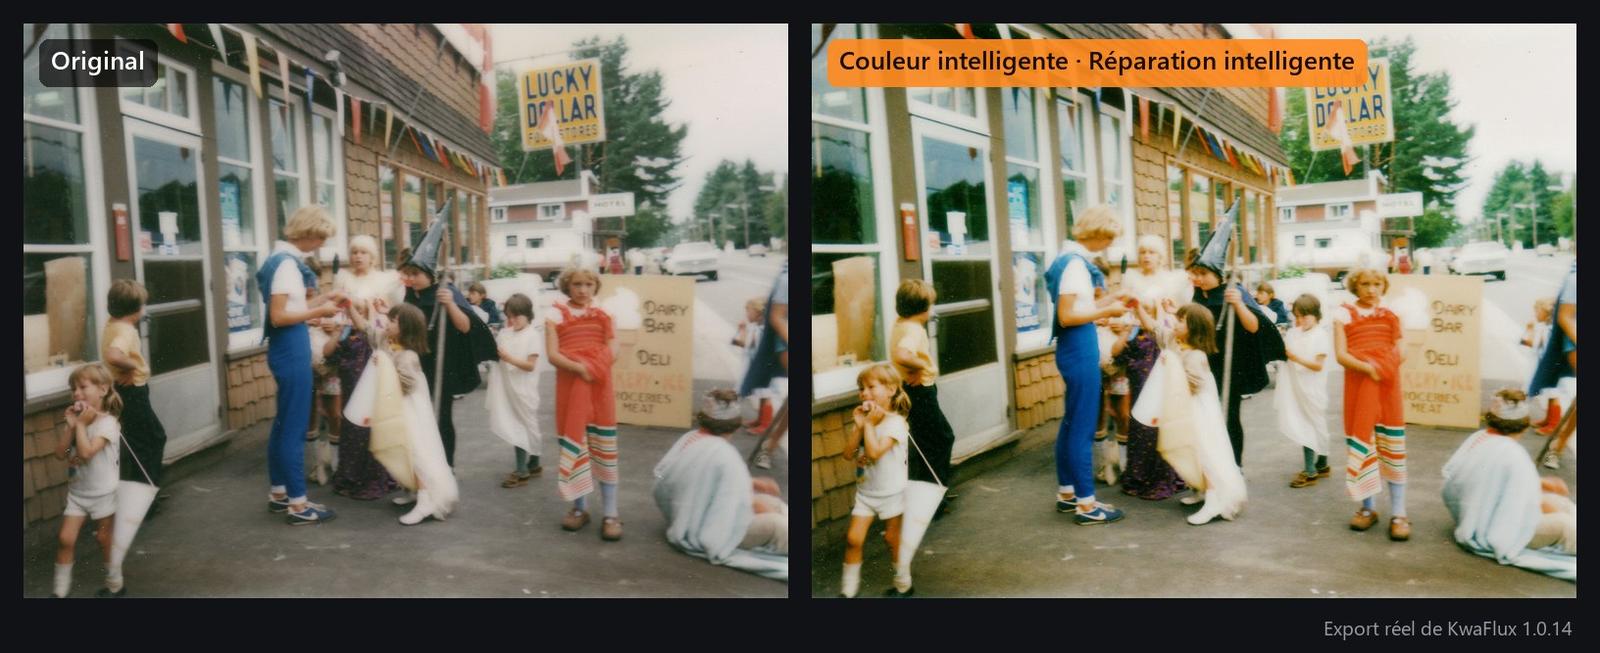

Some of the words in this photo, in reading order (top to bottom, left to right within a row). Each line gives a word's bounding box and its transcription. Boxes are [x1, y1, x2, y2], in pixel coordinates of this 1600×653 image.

[525, 64, 592, 100] LUCKY
[527, 94, 597, 128] DLAR
[643, 300, 689, 316] DAIRY
[1431, 300, 1477, 316] DAIRY
[643, 318, 675, 334] BAR
[1431, 318, 1463, 334] BAR
[637, 349, 671, 366] DELI
[1424, 349, 1459, 366] DELI
[616, 372, 651, 389] KERY
[623, 403, 654, 414] MEAT
